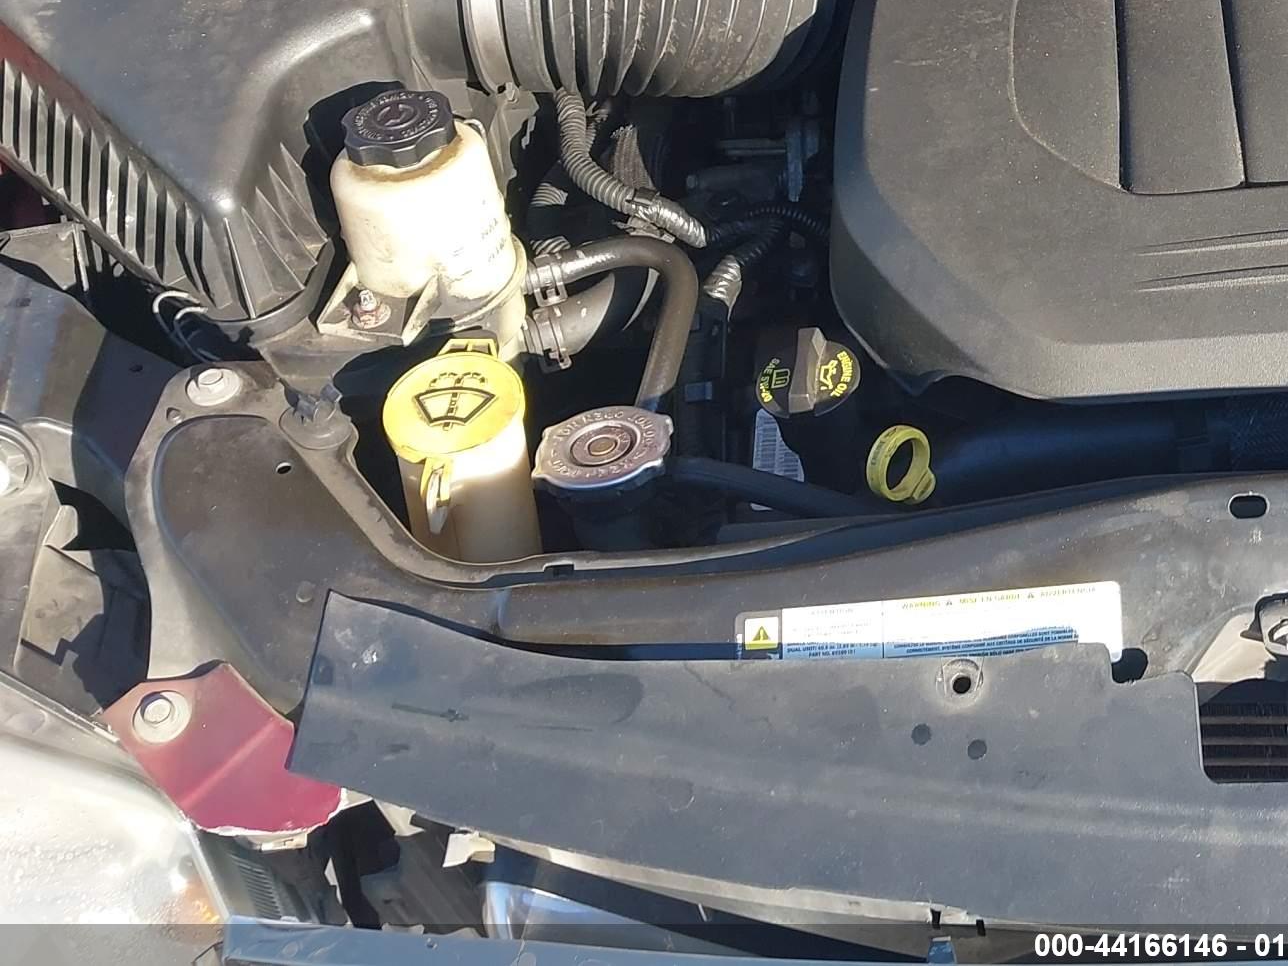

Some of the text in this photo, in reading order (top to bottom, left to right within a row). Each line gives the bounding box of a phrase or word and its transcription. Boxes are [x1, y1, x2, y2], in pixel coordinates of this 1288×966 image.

[764, 357, 780, 375] SAE
[830, 350, 853, 397] ENGINE OIL
[901, 600, 940, 610] WARNING
[1040, 586, 1096, 599] ADVERTENCIA
